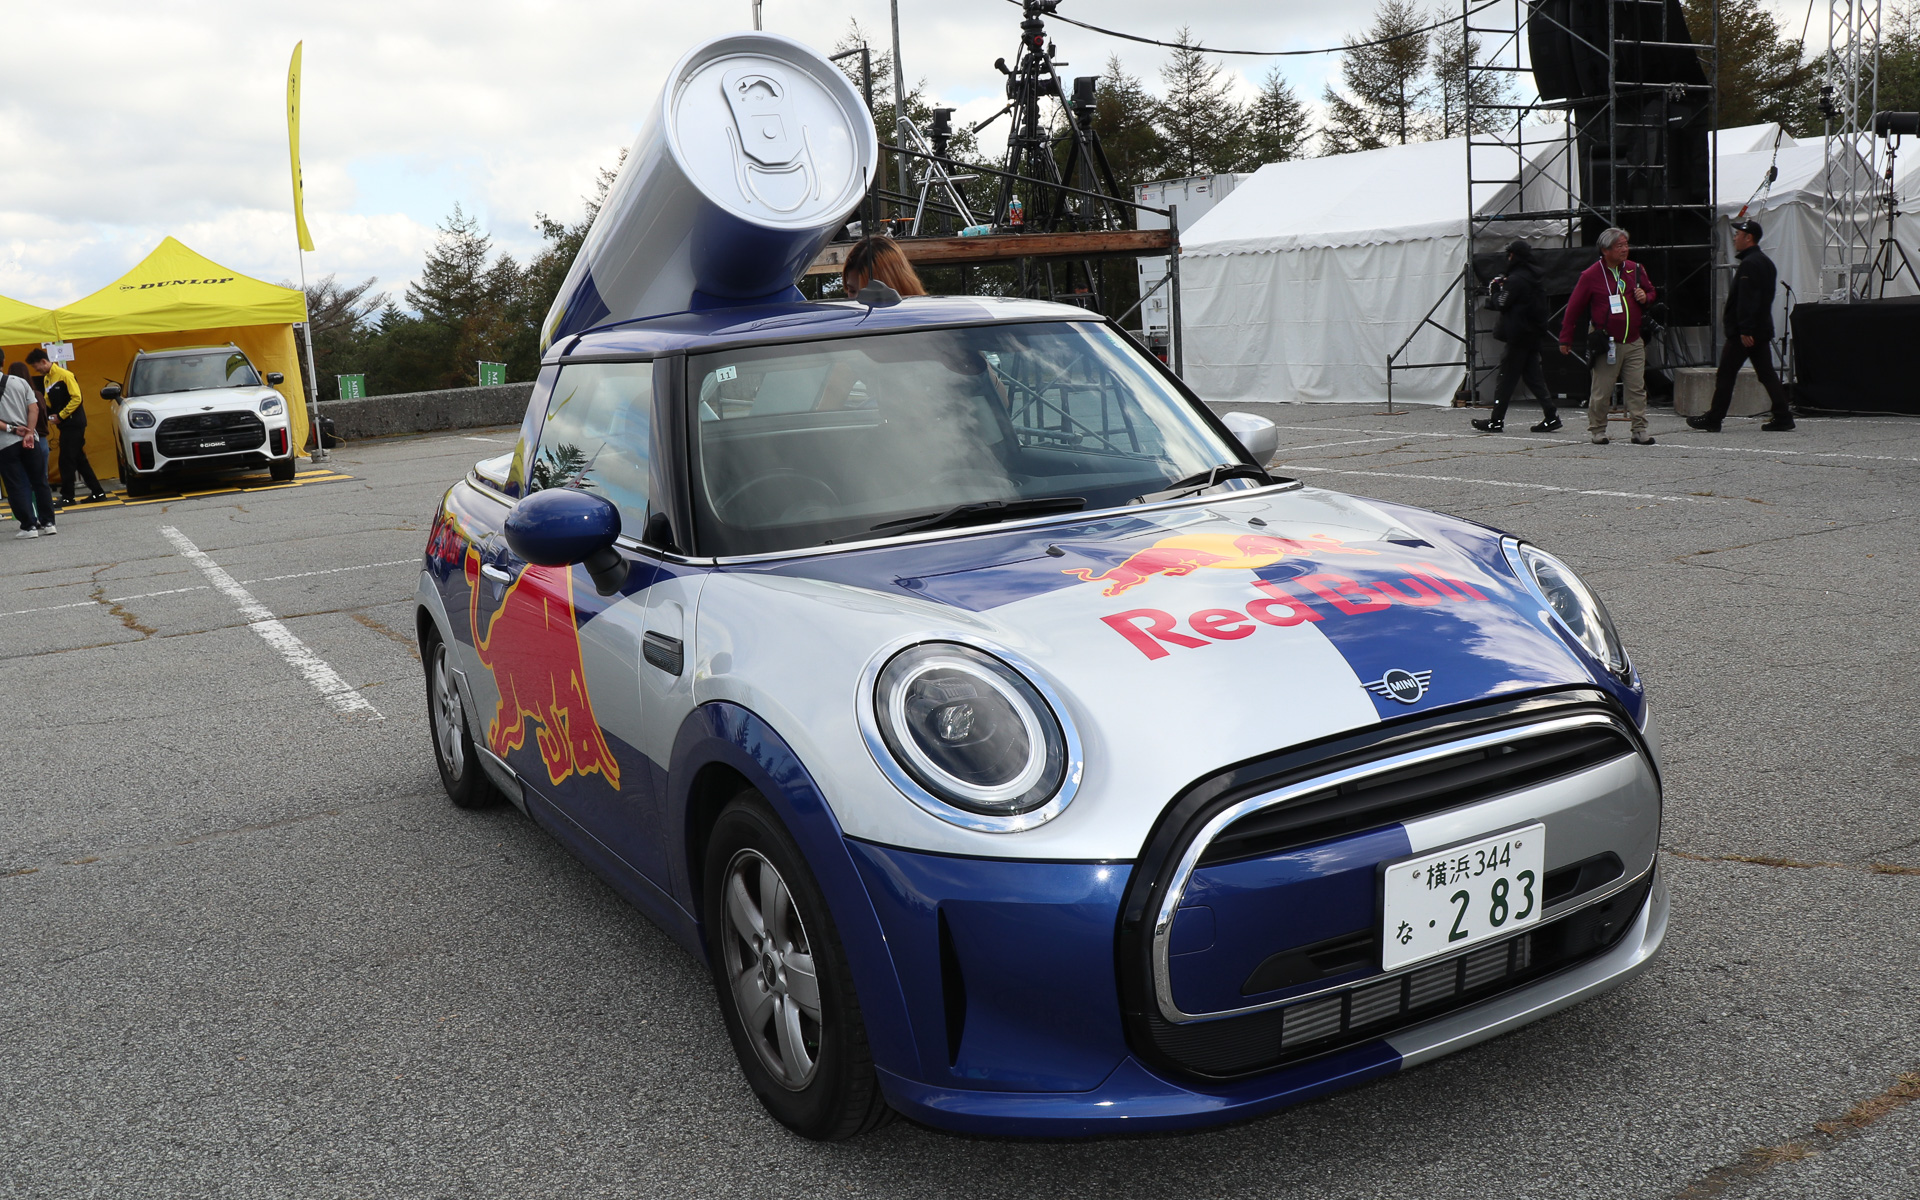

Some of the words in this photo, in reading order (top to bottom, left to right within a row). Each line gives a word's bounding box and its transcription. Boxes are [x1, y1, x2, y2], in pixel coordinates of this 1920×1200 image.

[138, 277, 234, 290] DUNLOP
[1099, 579, 1326, 661] Red
[1292, 562, 1491, 616] Bull
[1389, 678, 1417, 691] MINI
